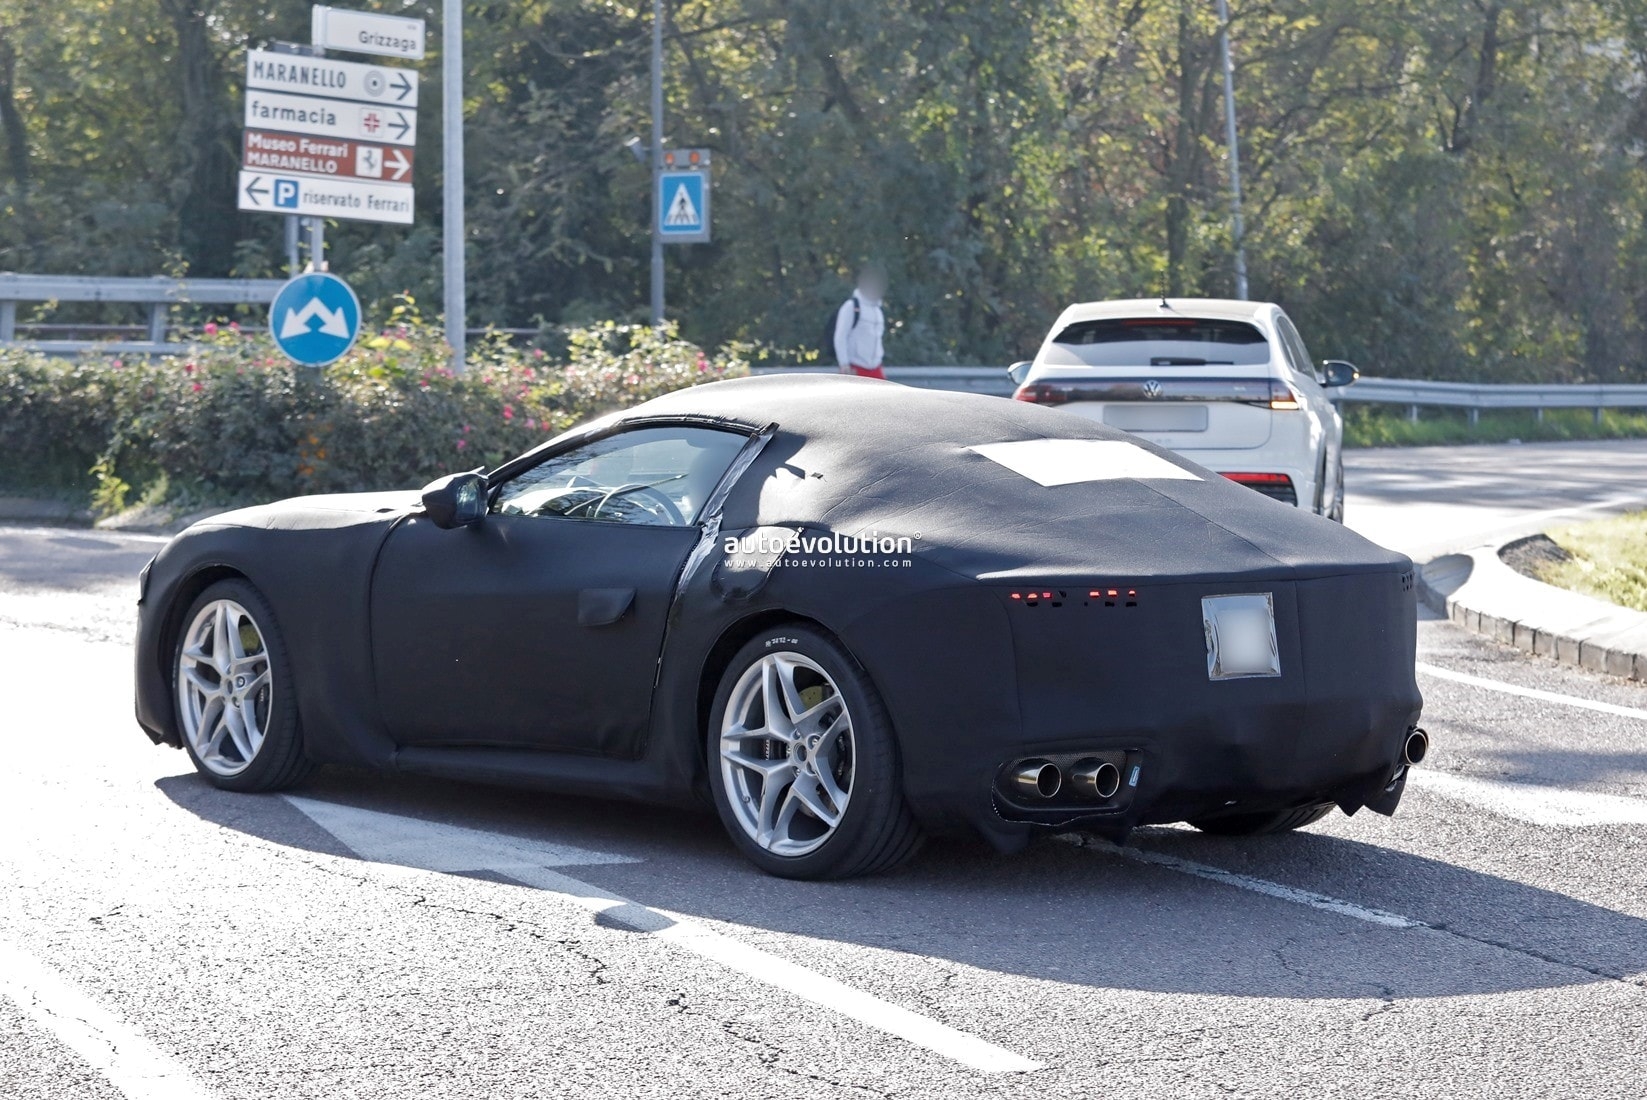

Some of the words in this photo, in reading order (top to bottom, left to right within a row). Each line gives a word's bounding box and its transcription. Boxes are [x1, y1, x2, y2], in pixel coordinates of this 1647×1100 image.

[358, 30, 416, 52] Grizzaga
[253, 61, 346, 88] MARANELLO
[252, 101, 336, 125] farmacia
[248, 132, 297, 152] Museo
[300, 139, 348, 157] Ferrari
[247, 152, 337, 173] MARANELLO
[277, 182, 296, 205] P
[303, 190, 361, 208] riservato
[367, 195, 409, 212] Ferrari
